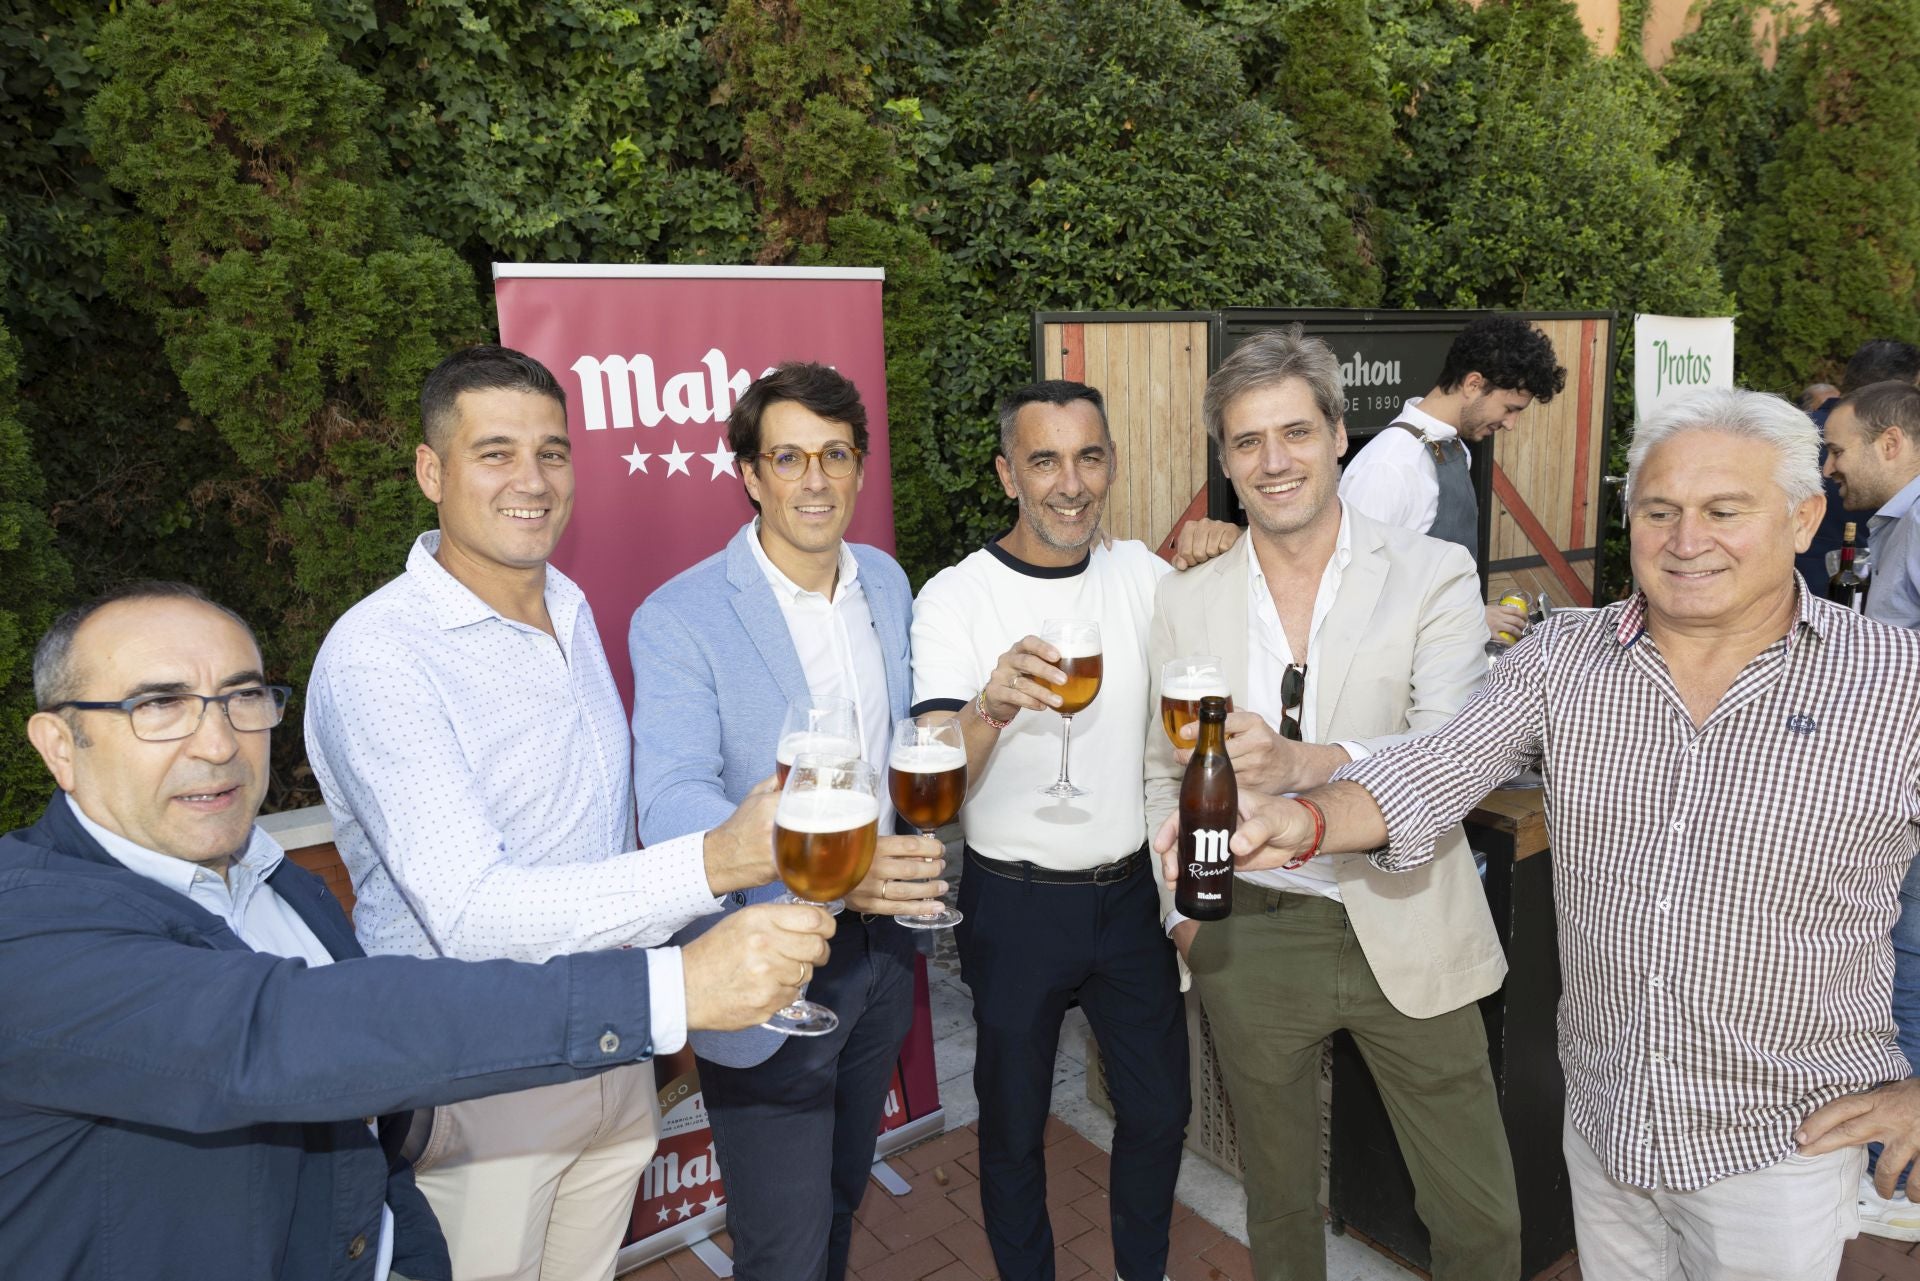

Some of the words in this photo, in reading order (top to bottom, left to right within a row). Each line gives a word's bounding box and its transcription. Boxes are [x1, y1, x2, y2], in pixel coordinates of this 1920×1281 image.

[1339, 351, 1402, 387] ahou
[1652, 339, 1712, 398] Protos
[569, 347, 780, 431] Mah
[1367, 395, 1400, 410] 1890
[1188, 863, 1231, 880] Reserva
